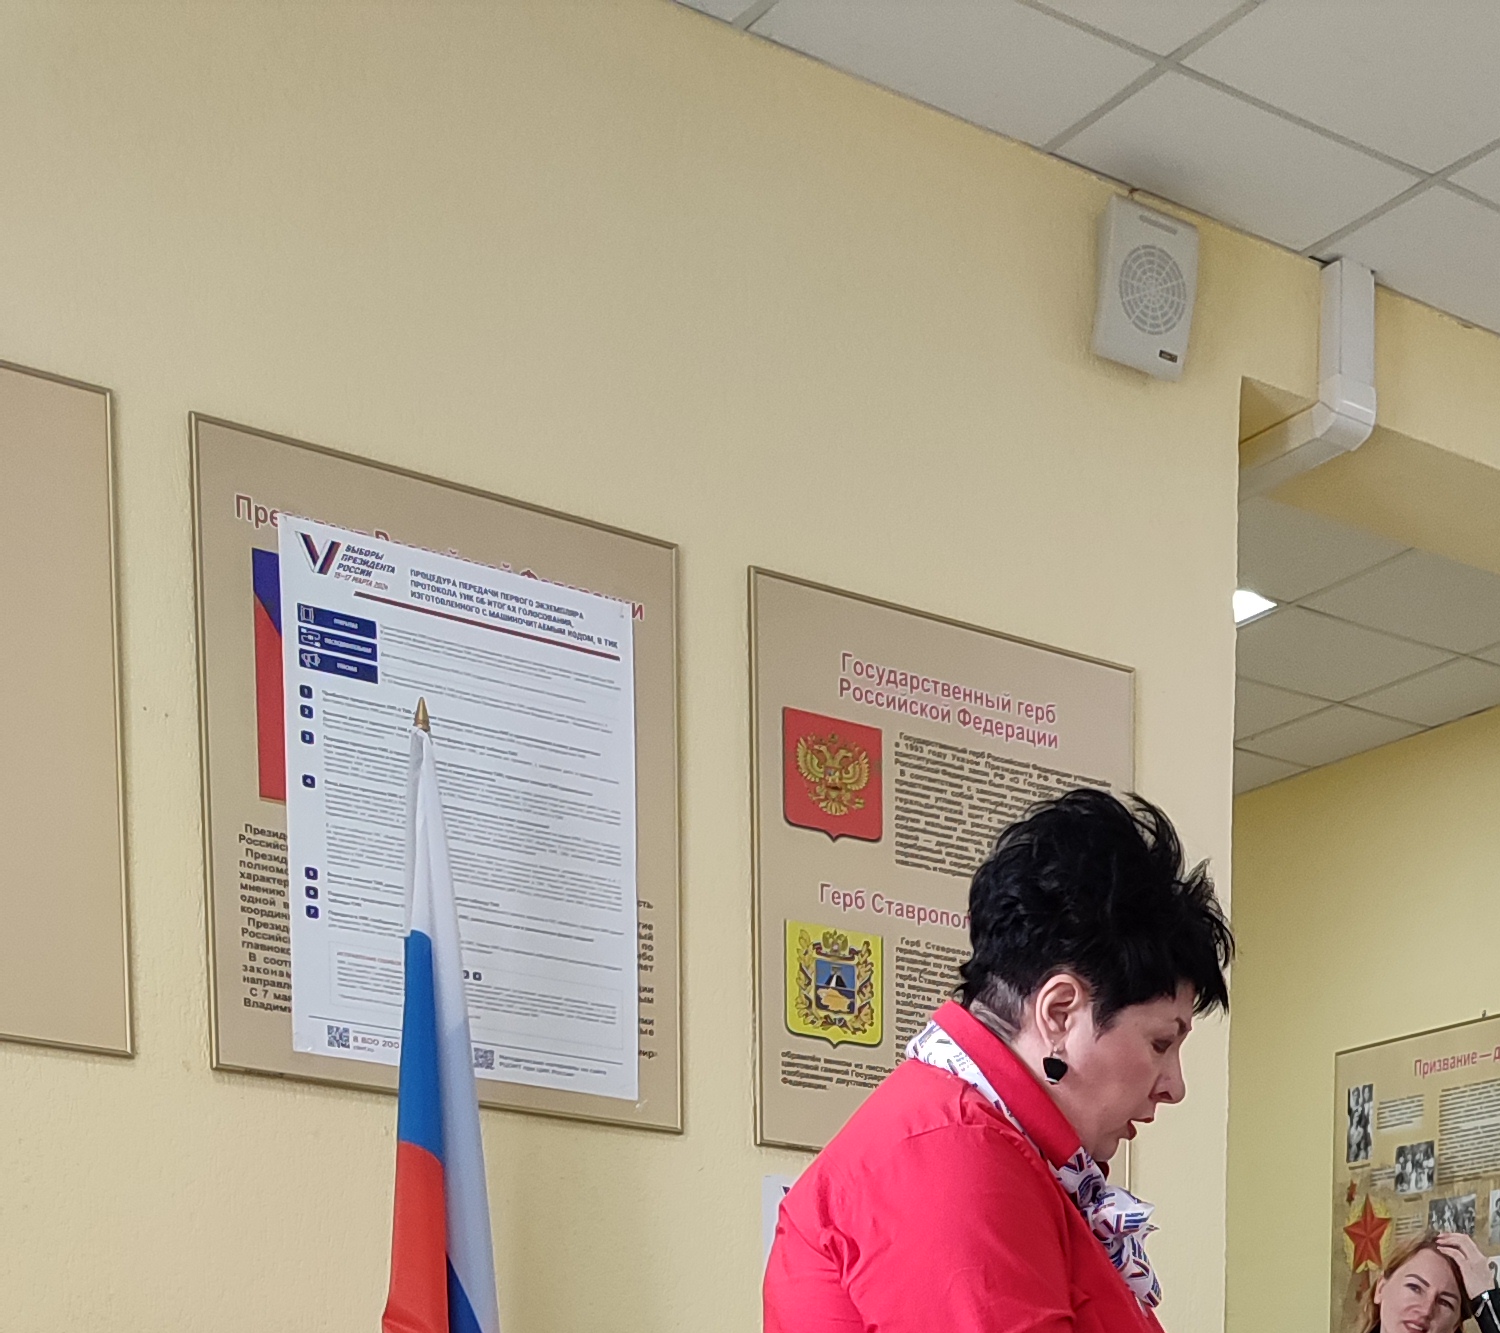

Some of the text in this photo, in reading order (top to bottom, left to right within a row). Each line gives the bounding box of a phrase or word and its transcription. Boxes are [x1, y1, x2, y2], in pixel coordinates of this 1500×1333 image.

[345, 544, 385, 561] ВЫБОРЫ
[337, 562, 373, 578] РОССИИ
[341, 553, 396, 575] ПРЕЗИДЕНТА
[410, 568, 457, 588] ПРОЦЕДУРА
[459, 581, 499, 599] ПЕРЕДАЧИ
[410, 579, 457, 598] ПРОТОКОЛА
[841, 652, 1057, 725] Государственный герб
[839, 677, 1059, 750] Российской Федерации
[240, 882, 286, 898] мнению
[819, 882, 866, 912] Герб
[240, 893, 276, 908] одной
[241, 926, 290, 945] Российс
[248, 951, 257, 962] В
[249, 987, 258, 998] С
[262, 989, 269, 999] 7
[1414, 1051, 1478, 1079] Призвание
